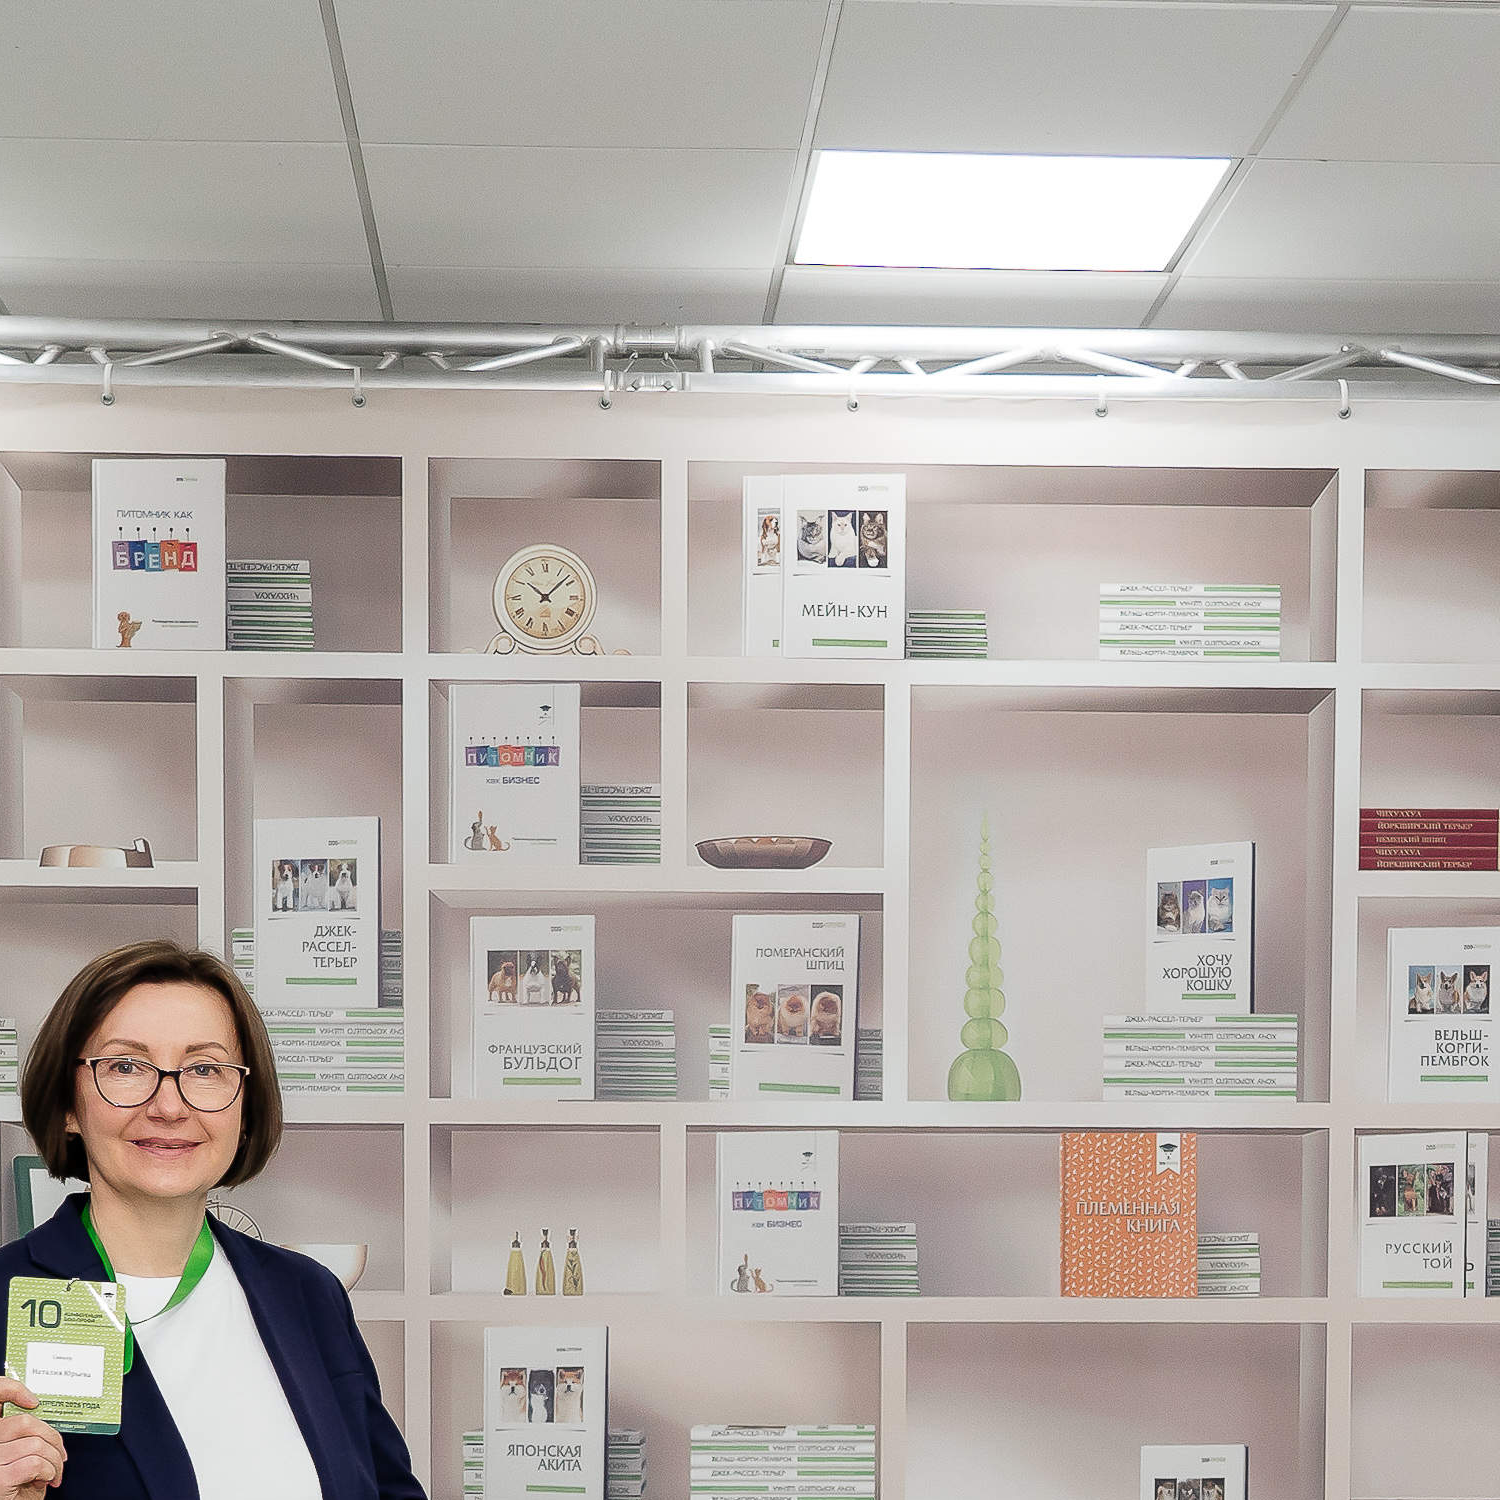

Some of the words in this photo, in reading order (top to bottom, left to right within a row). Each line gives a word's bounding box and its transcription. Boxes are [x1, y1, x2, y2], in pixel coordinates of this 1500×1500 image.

[116, 509, 171, 519] ПИТОМНИК
[173, 509, 194, 519] КАК
[115, 550, 196, 569] БРЕНД
[800, 601, 889, 622] МЕЙН-КУН
[466, 746, 559, 767] ПИТОМНИК
[501, 774, 541, 786] БИЗНЕС
[313, 925, 357, 939] ДЖЕК-
[302, 941, 357, 953] РАССЕЛ-
[755, 945, 846, 961] ПОМЕРАНСКИЙ
[312, 956, 358, 968] ТЕРЬЕР
[804, 959, 846, 973] ШПИЦ
[1196, 953, 1233, 968] ХОЧУ
[1161, 966, 1233, 981] ХОРОШУЮ
[1185, 979, 1233, 993] КОШКУ
[1433, 1028, 1490, 1043] ВЕЛЬШ-
[487, 1041, 583, 1057] ФРАНЦУЗСКИЙ
[1434, 1041, 1490, 1055] КОРГИ-
[502, 1055, 584, 1074] БУЛЬДОГ
[1419, 1053, 1490, 1069] ПЕМБРОК
[733, 1192, 820, 1211] ПИТОМНИК
[1074, 1199, 1182, 1218] ПЛЕМЕННАЯ
[766, 1218, 804, 1230] БИЗНЕС
[1125, 1216, 1182, 1234] КНИГА
[1383, 1239, 1454, 1257] РУССКИЙ
[1421, 1254, 1454, 1270] ТОЙ
[20, 1299, 62, 1329] 10
[505, 1441, 584, 1460] ЯПОНСКАЯ
[536, 1457, 584, 1474] АКИТА
